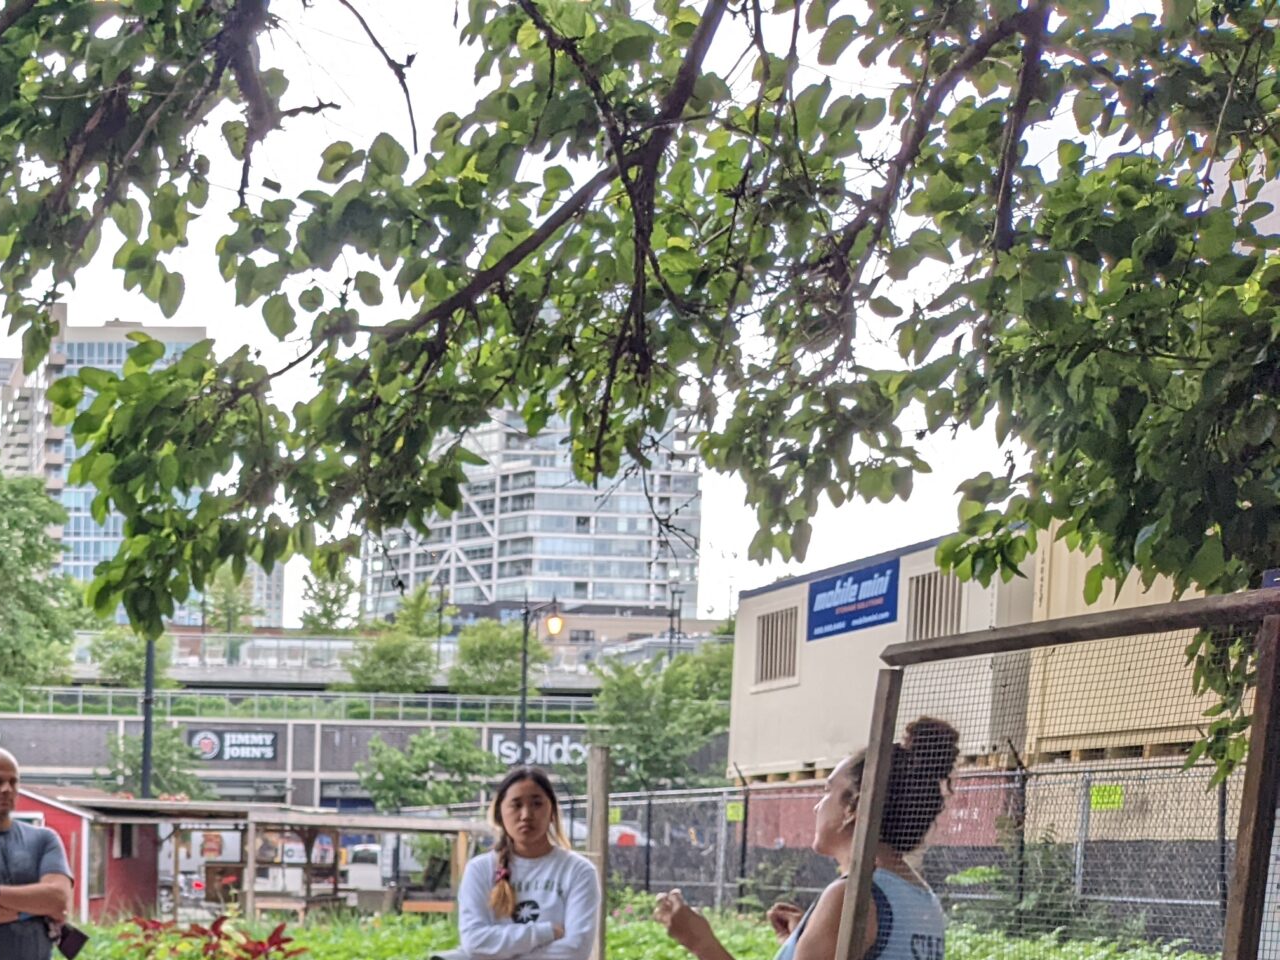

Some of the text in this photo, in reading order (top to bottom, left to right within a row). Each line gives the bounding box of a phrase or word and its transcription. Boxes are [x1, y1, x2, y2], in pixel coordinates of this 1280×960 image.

[813, 576, 859, 613] mobile
[858, 569, 893, 601] mini
[223, 732, 275, 746] JIMMY
[223, 746, 275, 760] JOHN'S
